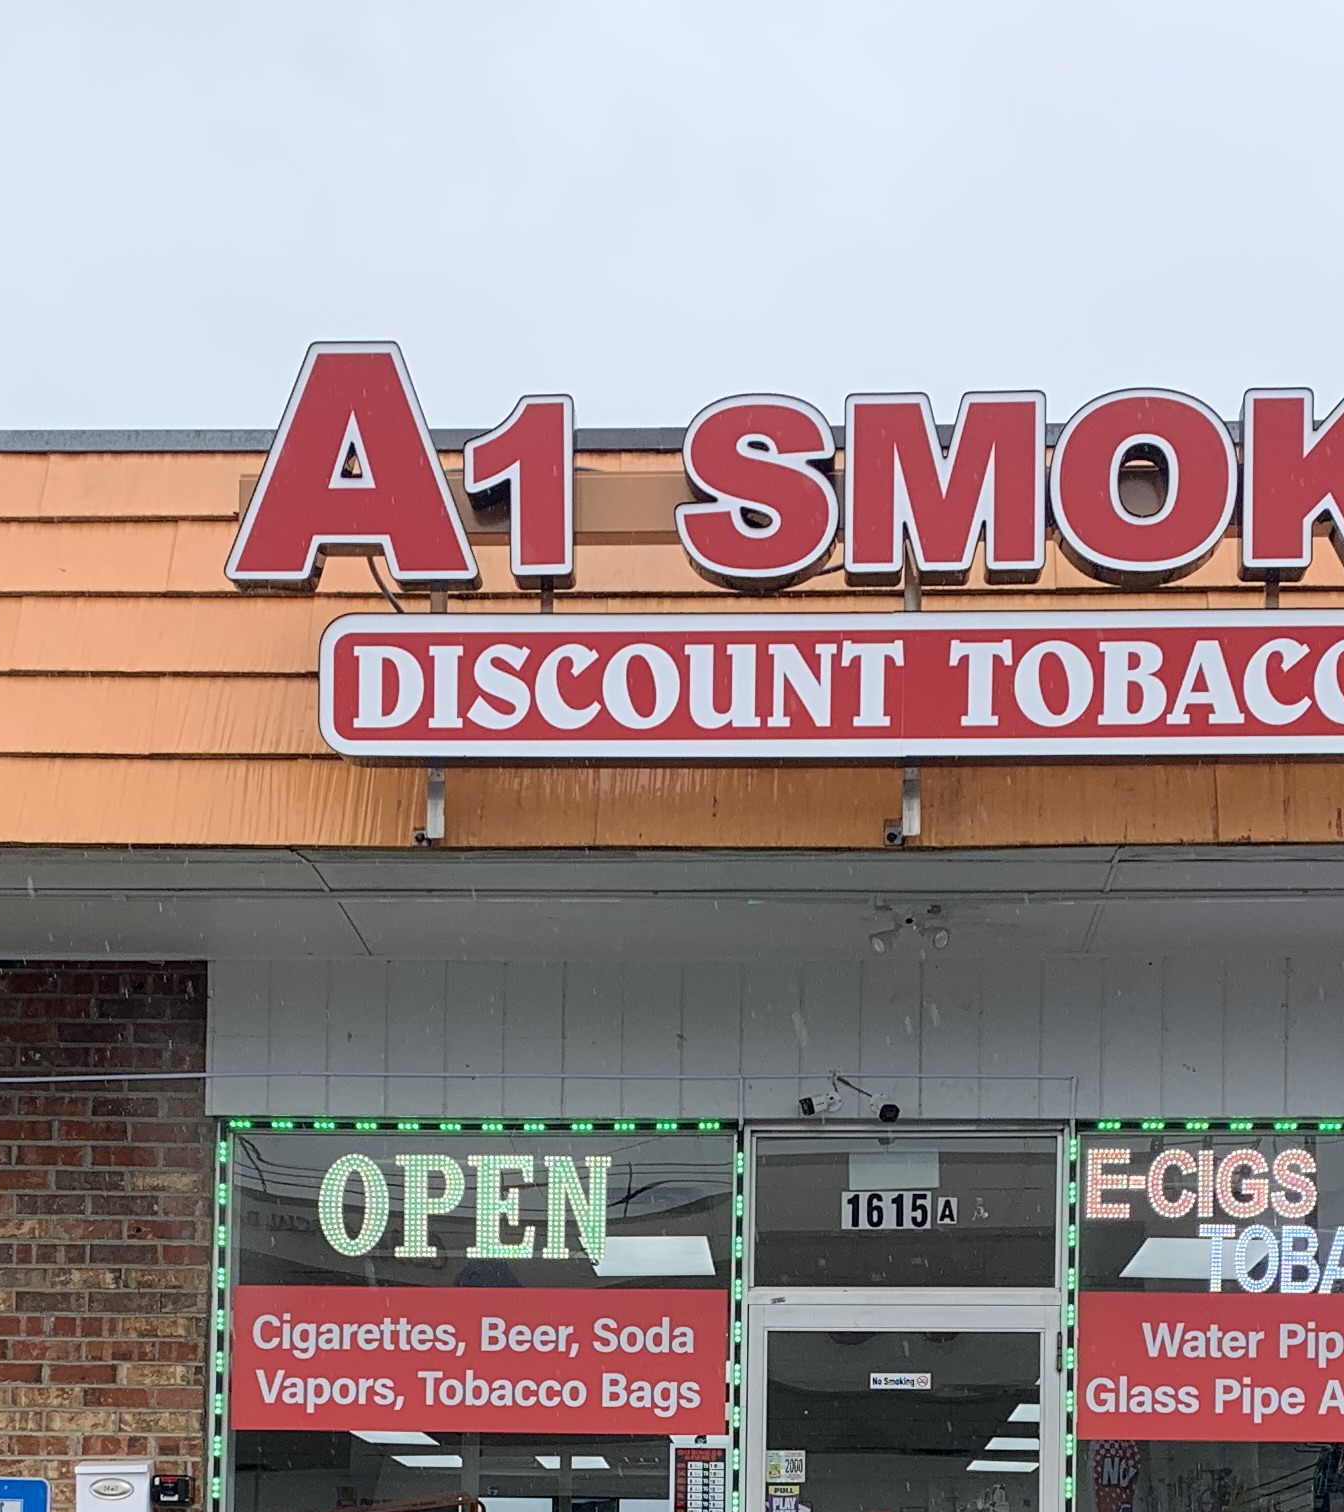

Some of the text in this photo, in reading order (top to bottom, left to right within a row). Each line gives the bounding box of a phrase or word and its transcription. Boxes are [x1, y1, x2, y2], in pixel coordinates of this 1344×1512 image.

[225, 342, 574, 586] A1
[352, 640, 904, 731] DISCOUNT
[317, 1153, 613, 1260] OPEN
[1085, 1147, 1318, 1219] E-CIGS
[846, 1192, 955, 1228] 1615 A
[252, 1313, 695, 1359] Cigarettes, Beer, Soda
[1142, 1322, 1265, 1359] Water
[255, 1369, 702, 1418] Vapors, Tobacco Bags
[872, 1376, 915, 1388] No Smoking
[1086, 1376, 1200, 1415] Glass
[1213, 1376, 1305, 1424] Pipe
[772, 1496, 797, 1510] PLAY
